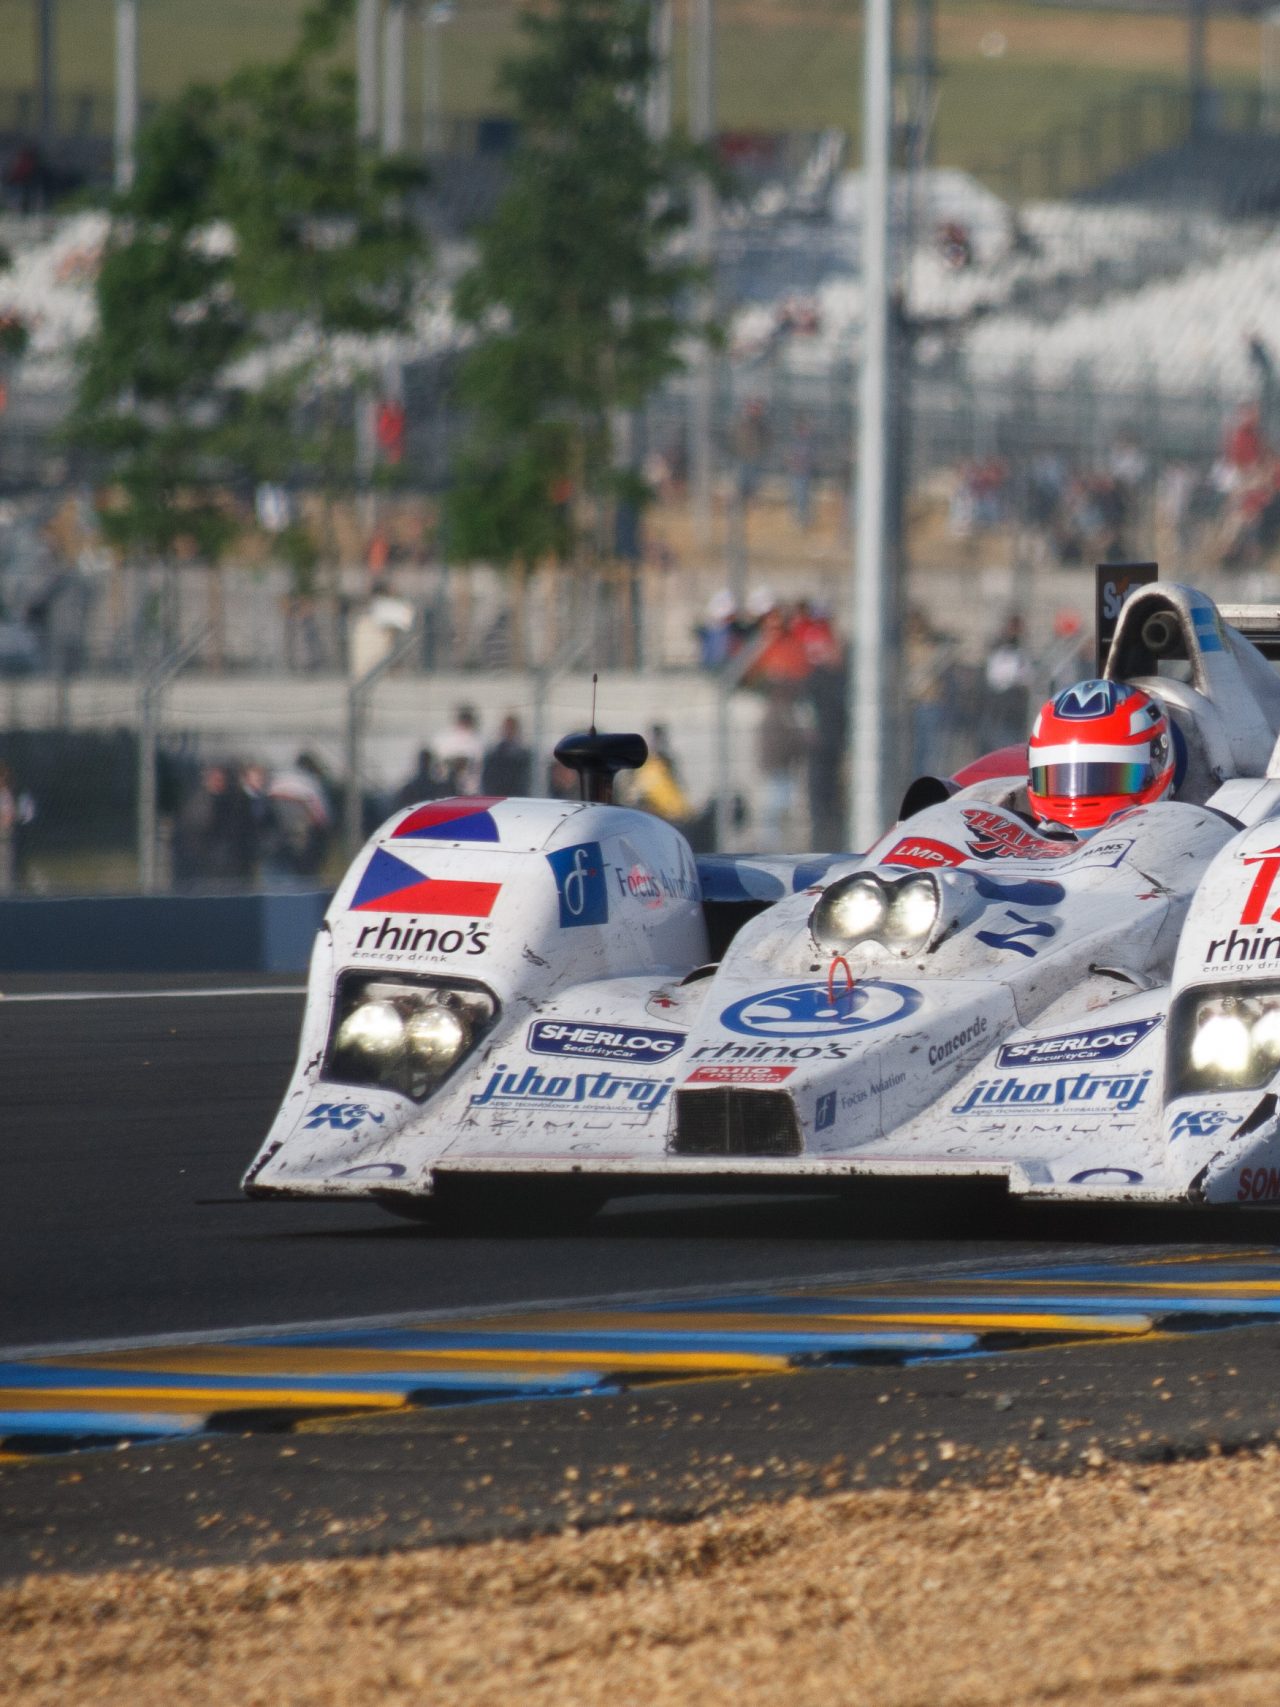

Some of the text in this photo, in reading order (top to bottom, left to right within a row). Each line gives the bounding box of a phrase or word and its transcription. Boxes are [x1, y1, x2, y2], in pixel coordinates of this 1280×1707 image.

[894, 844, 954, 866] LMP1
[356, 917, 490, 955] rhino's
[351, 951, 448, 962] energy drink
[1203, 962, 1253, 973] energy
[538, 1024, 675, 1053] SHERLOG
[690, 1042, 853, 1059] rhino's
[928, 1016, 988, 1066] Concorde
[1007, 1032, 1138, 1058] SHERLOG
[841, 1071, 906, 1110] Focus Aviation
